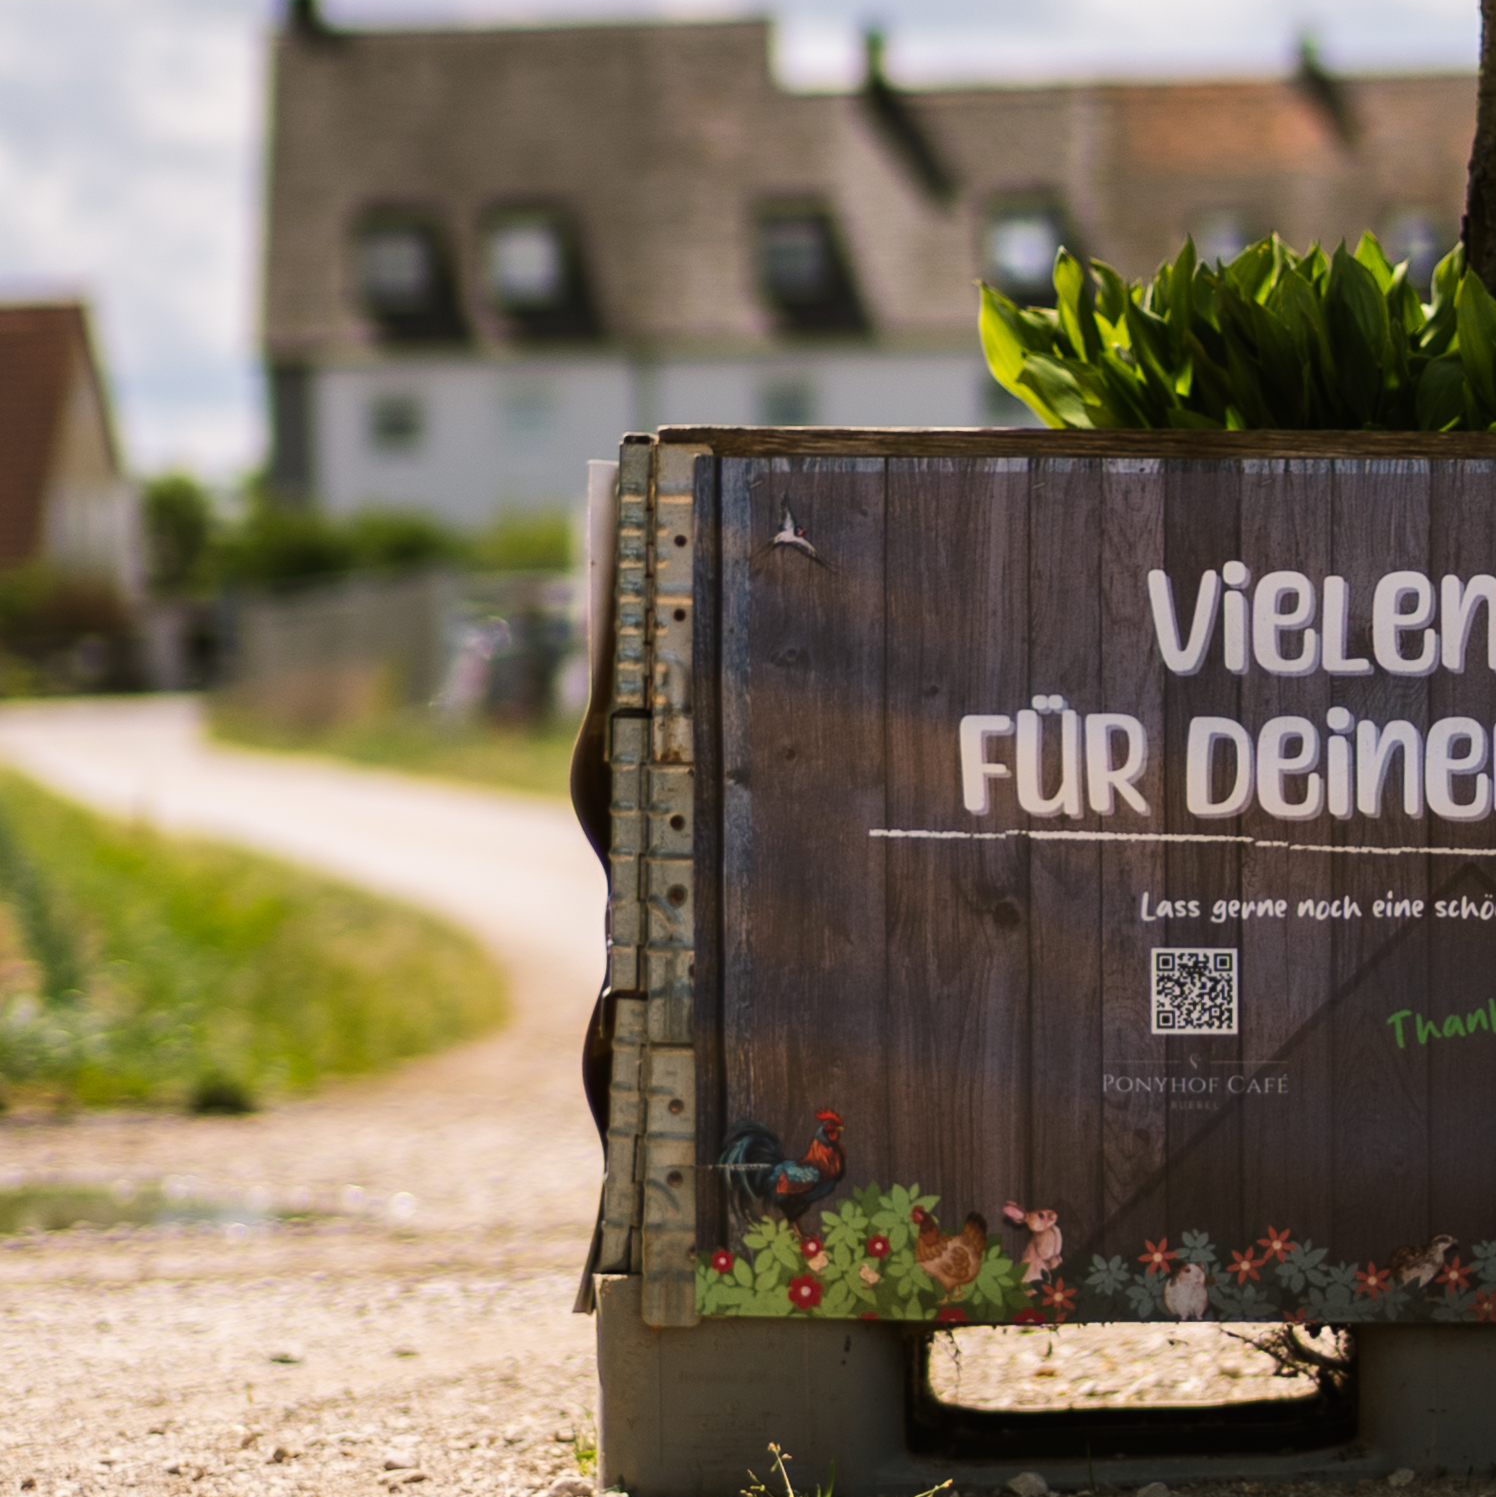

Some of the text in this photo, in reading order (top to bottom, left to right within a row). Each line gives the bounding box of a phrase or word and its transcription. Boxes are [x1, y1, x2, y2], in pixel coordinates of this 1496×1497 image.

[958, 695, 1151, 820] FÜR
[1141, 892, 1200, 921] Lass
[1211, 898, 1287, 923] gerne
[1297, 895, 1362, 920] noch
[1372, 891, 1424, 918] eine
